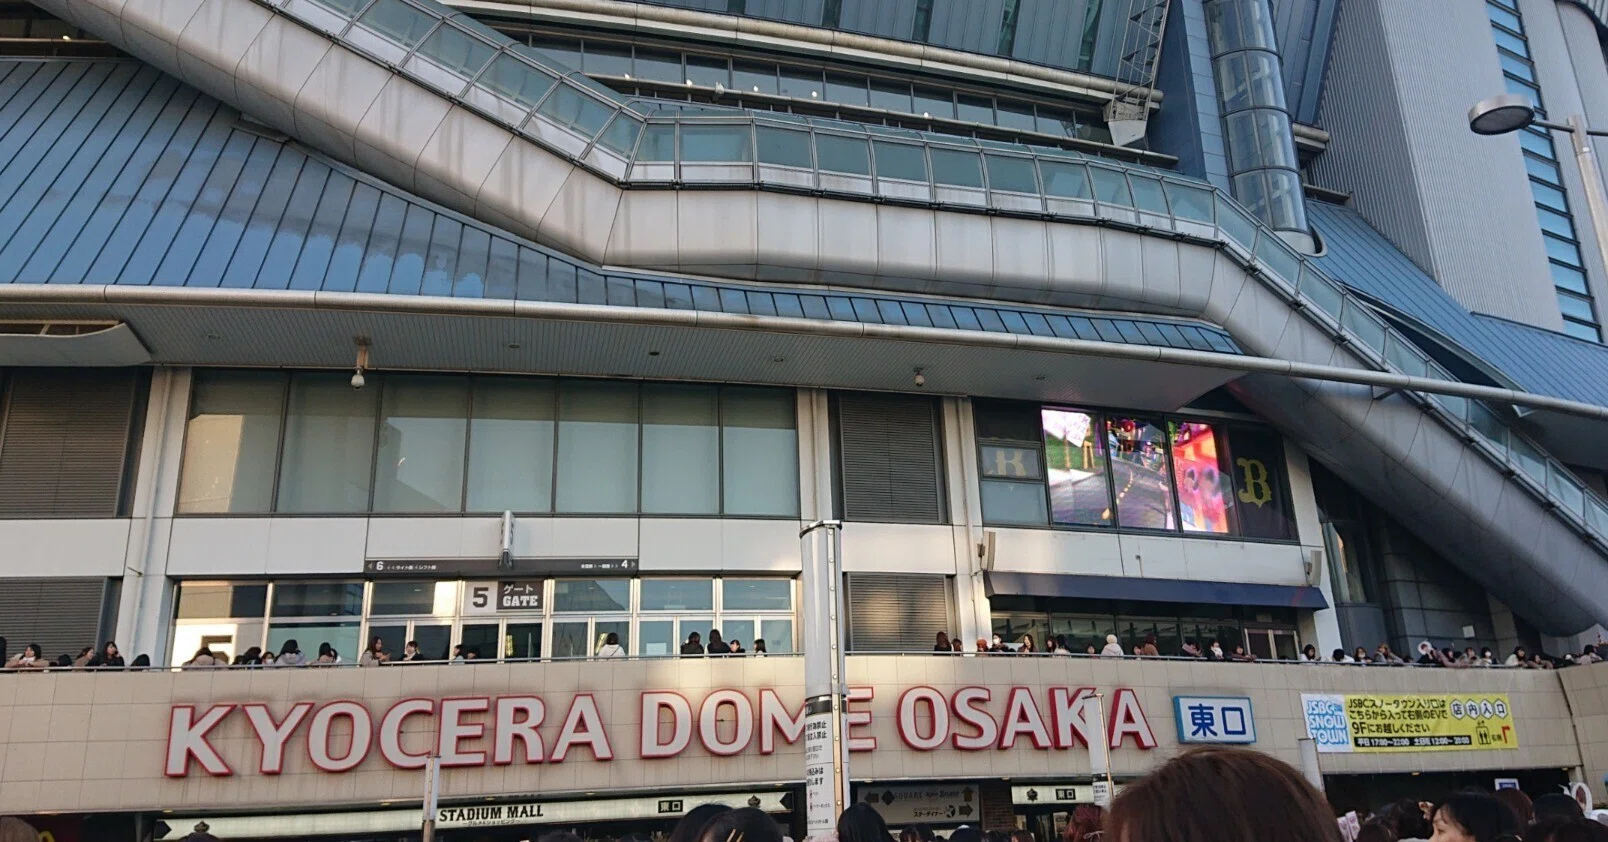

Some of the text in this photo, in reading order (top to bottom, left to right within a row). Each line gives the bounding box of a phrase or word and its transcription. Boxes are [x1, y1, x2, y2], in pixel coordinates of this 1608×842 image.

[376, 561, 384, 571] 6
[621, 560, 629, 570] 4
[504, 584, 534, 595] ゲート
[472, 587, 489, 608] 5
[502, 595, 538, 607] GATE
[1307, 700, 1334, 715] JSBC
[1188, 704, 1246, 737] 東口
[1309, 715, 1347, 728] SNOW
[164, 685, 1158, 777] KYOCERA DOME OSAKA
[1311, 729, 1349, 745] TOWN
[1057, 789, 1074, 799] 東口
[439, 804, 544, 822] STADIUM MALL
[661, 802, 682, 812] 東口
